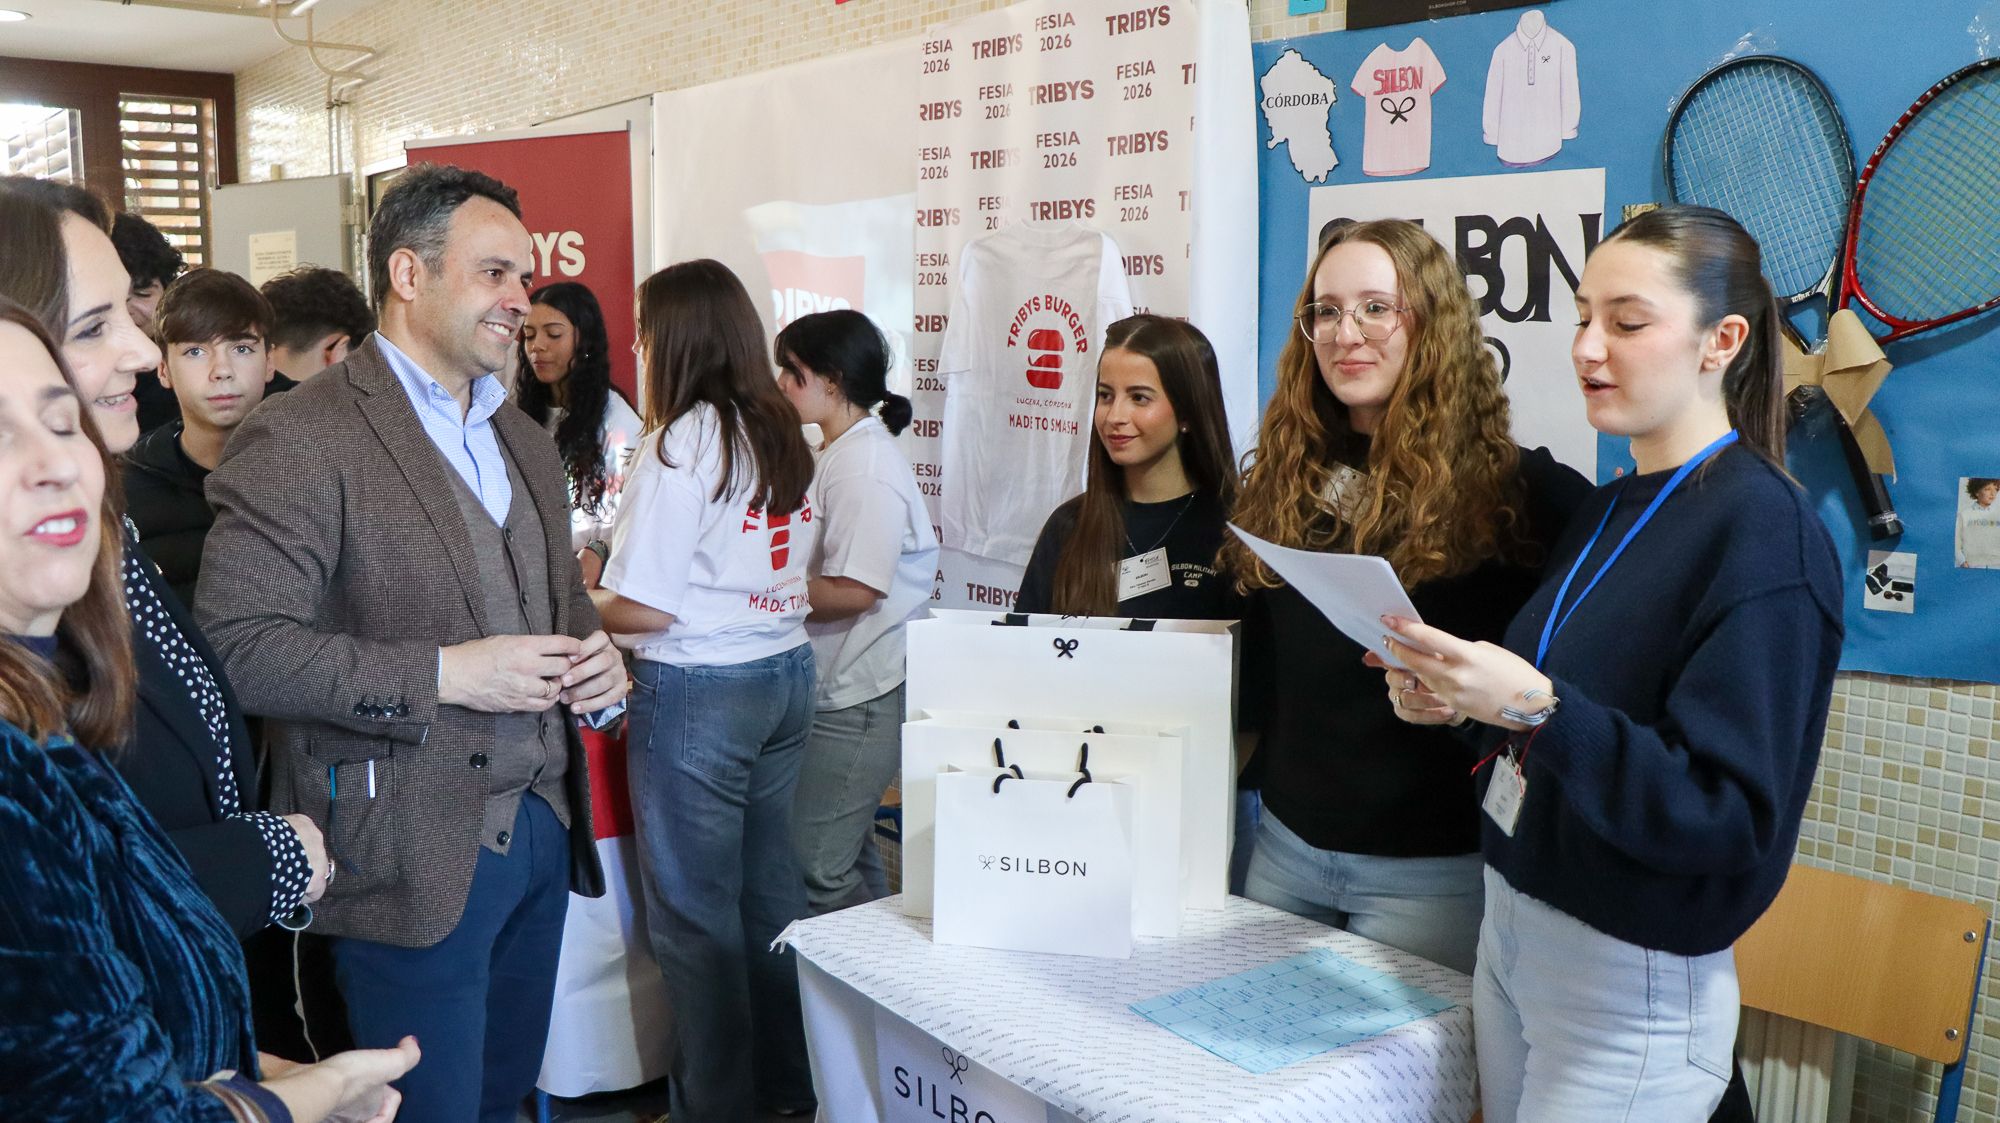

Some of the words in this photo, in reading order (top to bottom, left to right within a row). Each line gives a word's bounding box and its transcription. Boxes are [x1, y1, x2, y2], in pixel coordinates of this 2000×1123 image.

[1035, 12, 1076, 32] FESIA
[1106, 5, 1171, 36] TRIBYS
[922, 39, 953, 55] ESIA
[972, 33, 1023, 60] TRIBYS
[1040, 34, 1072, 51] 2026
[923, 58, 950, 74] 2026
[1117, 60, 1156, 80] FESIA
[1373, 66, 1424, 96] SILBON
[979, 83, 1014, 101] FESIA
[1028, 79, 1095, 106] TRIBYS
[1124, 82, 1152, 100] 2026
[920, 99, 962, 121] RIBYS
[1266, 92, 1330, 110] CÓRDOBA
[985, 103, 1012, 120] 2026
[1036, 131, 1081, 149] FESIA
[1107, 130, 1169, 157] TRIBYS
[918, 146, 952, 161] ESIA
[1043, 152, 1077, 169] 2026
[920, 165, 949, 180] 2026
[1114, 184, 1153, 201] FESIA
[917, 207, 961, 227] RIBYS
[1030, 198, 1096, 222] TRIBYS
[1120, 206, 1149, 222] 2026
[916, 253, 950, 267] ESIA
[918, 272, 948, 286] 2026
[1007, 296, 1041, 348] TRIBYS
[1044, 294, 1089, 354] BURGER
[1009, 413, 1034, 431] MADE
[1035, 416, 1049, 431] TO
[1050, 417, 1079, 436] SMASH
[917, 481, 942, 497] 026
[1171, 563, 1193, 571] SILBON
[1183, 571, 1203, 579] CAMP
[748, 593, 787, 613] MADE
[999, 855, 1087, 877] SILBON
